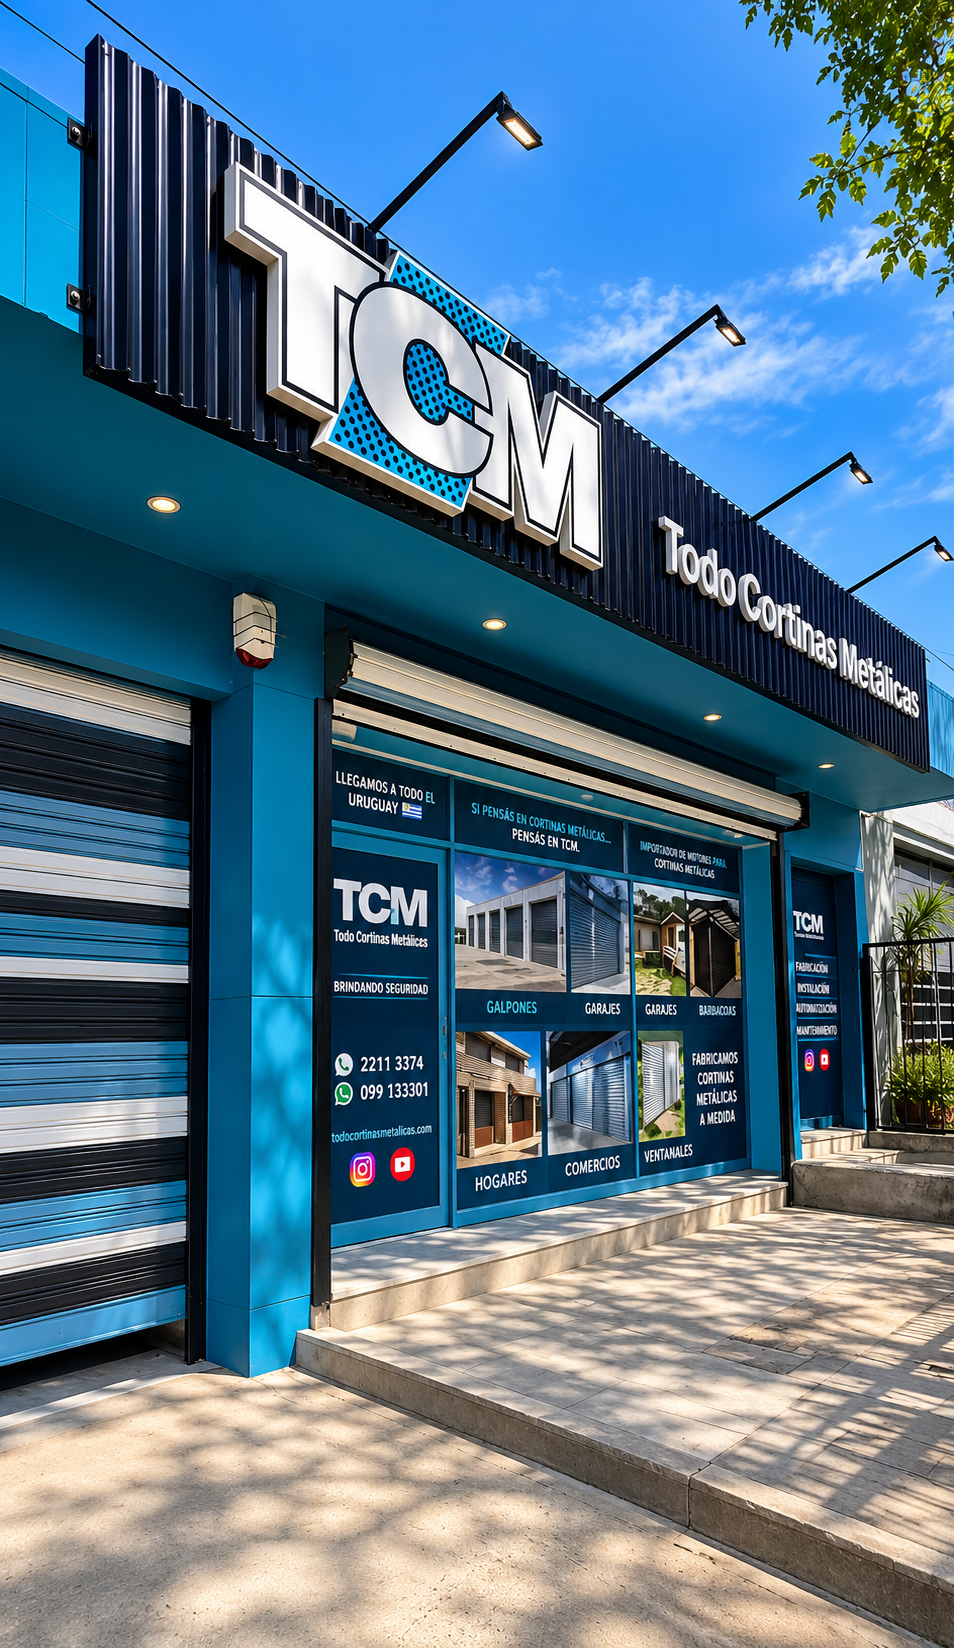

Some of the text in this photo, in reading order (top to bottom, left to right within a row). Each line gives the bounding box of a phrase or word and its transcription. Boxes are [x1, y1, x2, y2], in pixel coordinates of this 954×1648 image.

[224, 162, 602, 570] TCM
[658, 515, 920, 719] Todo Cortinas Metálicas
[335, 770, 436, 804] LLEGAMOS A TODO EL
[348, 792, 399, 815] URUGUAY
[471, 802, 480, 815] SI
[482, 805, 515, 822] PENSÁS
[516, 813, 527, 825] EN
[528, 816, 566, 834] CORTINAS
[511, 828, 546, 846] PENSÁS
[547, 835, 559, 848] EN
[679, 849, 687, 860] DE
[333, 878, 428, 928] TCM
[793, 910, 824, 934] TCM
[333, 929, 355, 943] Todo
[356, 930, 390, 945] Cortinas
[333, 980, 429, 995] BRINDANDO SEGURIDAD
[486, 1000, 538, 1014] GALPONES
[585, 1002, 621, 1016] GARAJES
[645, 1003, 678, 1016] GARAJES
[360, 1055, 424, 1072] 2211 3374
[692, 1052, 739, 1066] FABRICAMOS
[697, 1071, 734, 1086] CORTINAS
[360, 1081, 429, 1100] 099 133301
[696, 1088, 738, 1106] METÁLICAS
[699, 1110, 736, 1126] A MEDIDA
[331, 1125, 433, 1143] todocortinasmetalicas.com
[644, 1144, 693, 1163] VENTANALES
[565, 1155, 621, 1177] COMERCIOS
[475, 1170, 528, 1192] HOGARES
